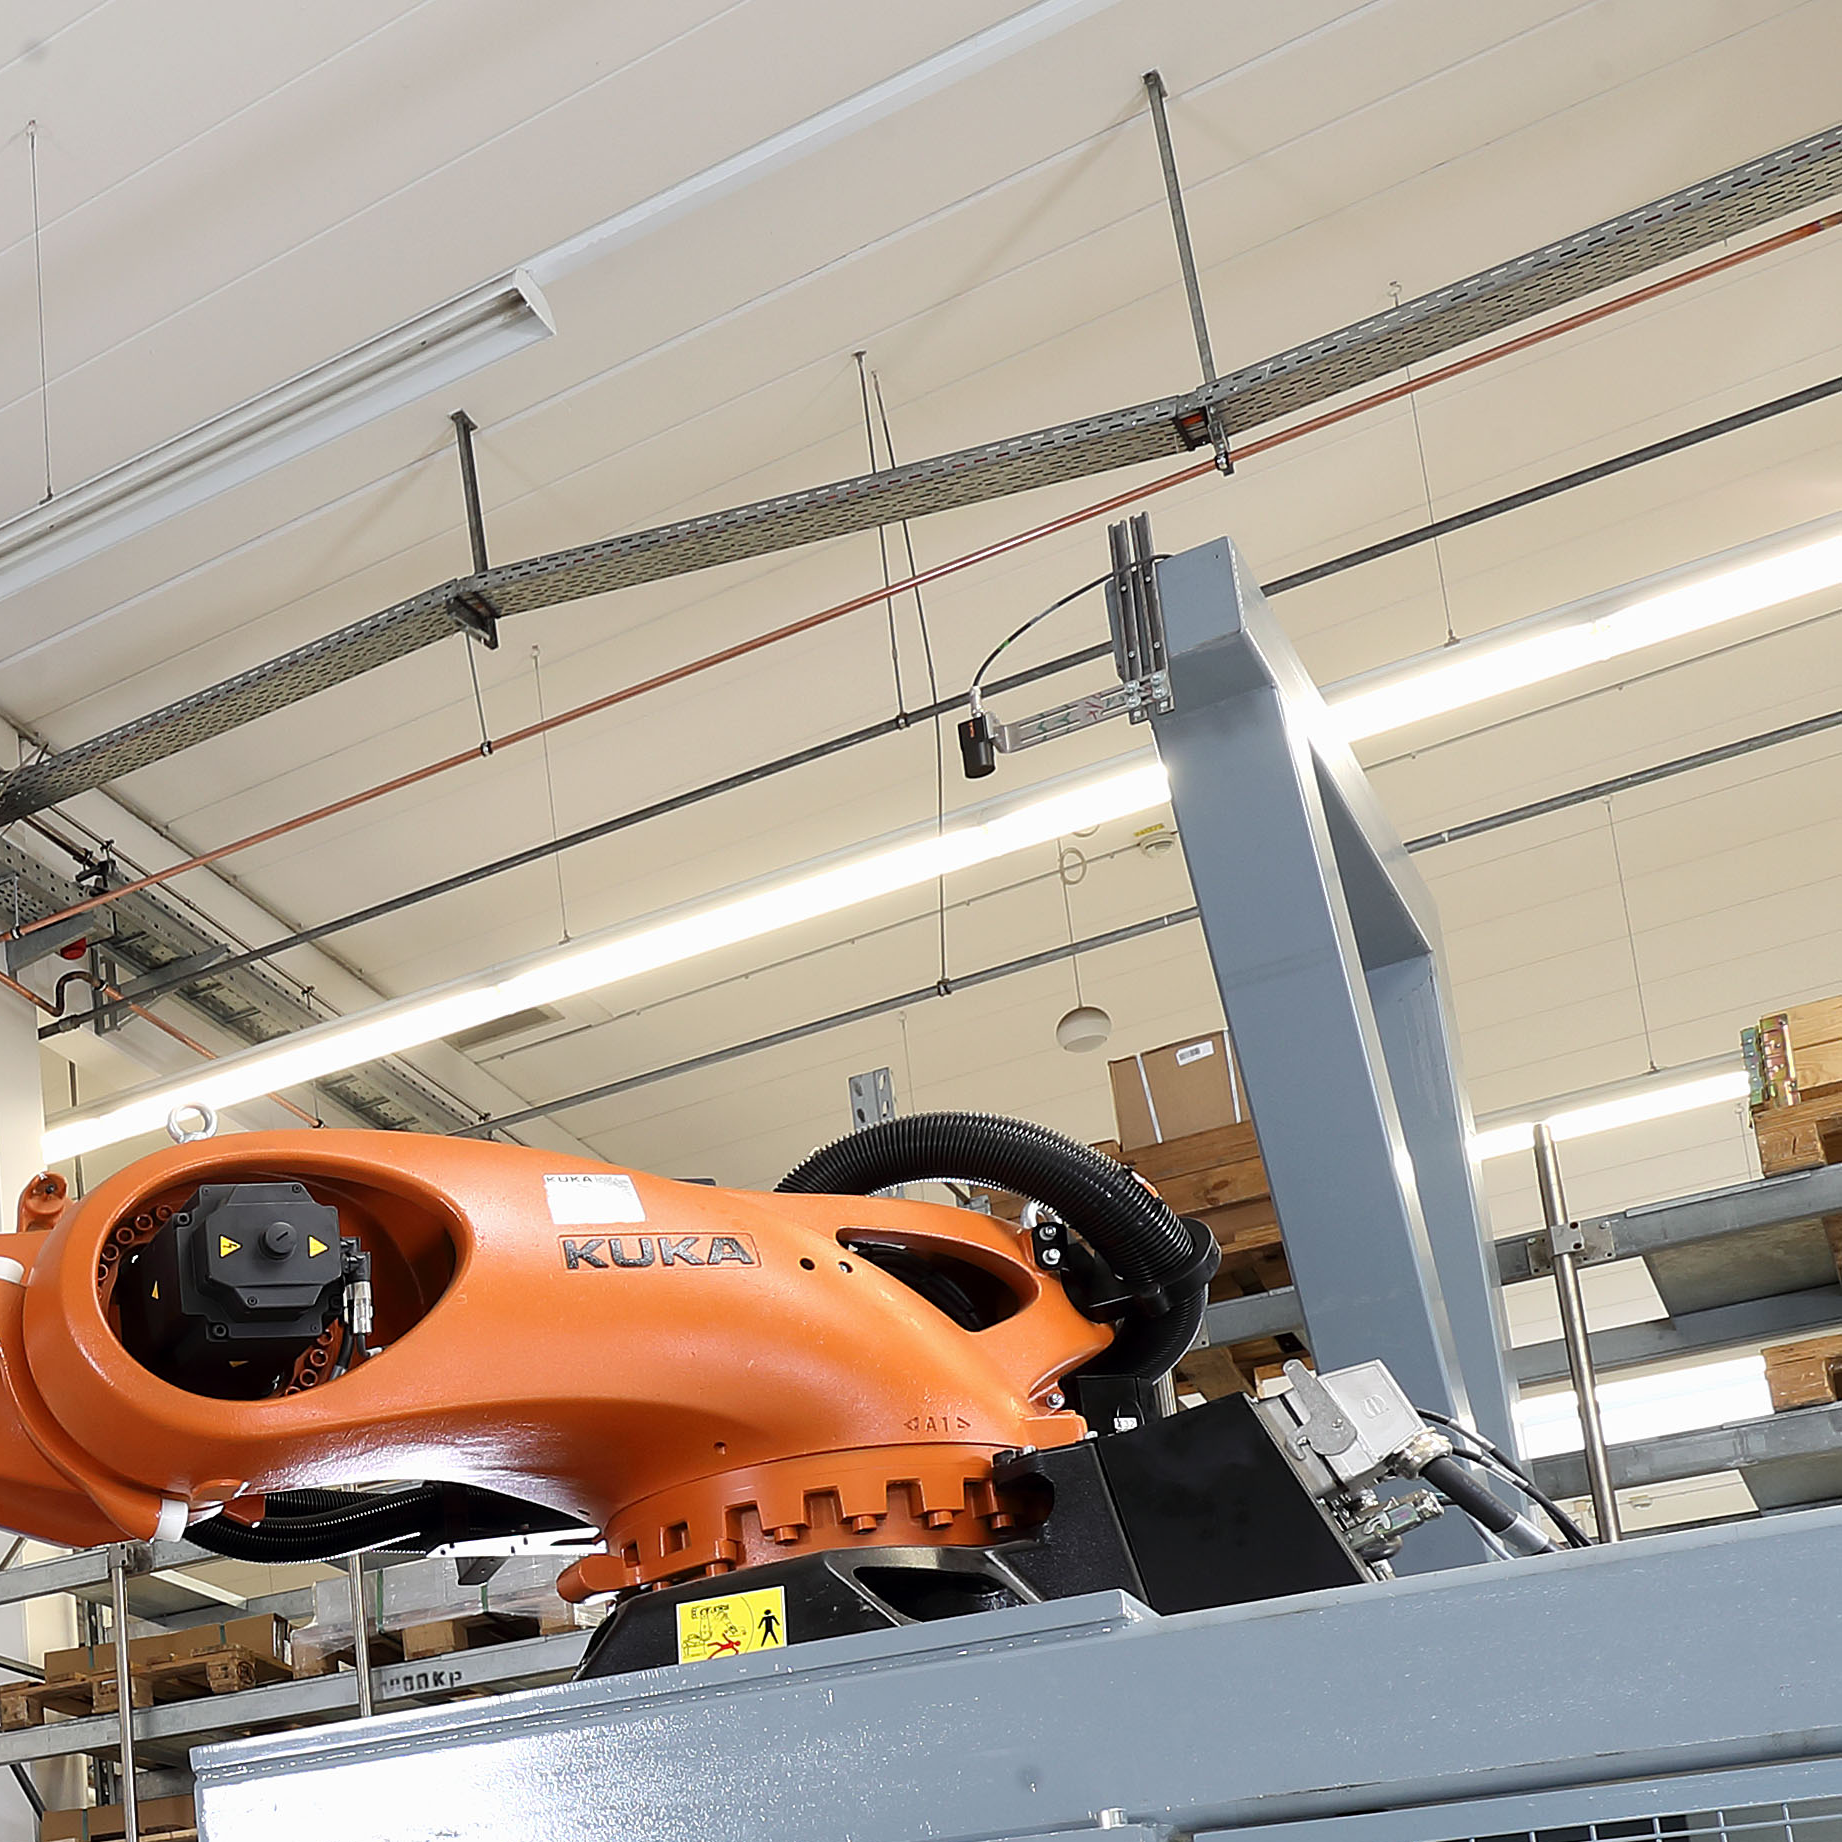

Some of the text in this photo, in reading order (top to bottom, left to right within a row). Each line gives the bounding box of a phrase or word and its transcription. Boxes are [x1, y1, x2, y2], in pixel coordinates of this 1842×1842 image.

[545, 1175, 593, 1183] KUKA
[562, 1237, 755, 1270] KUKA
[925, 1415, 949, 1433] A1
